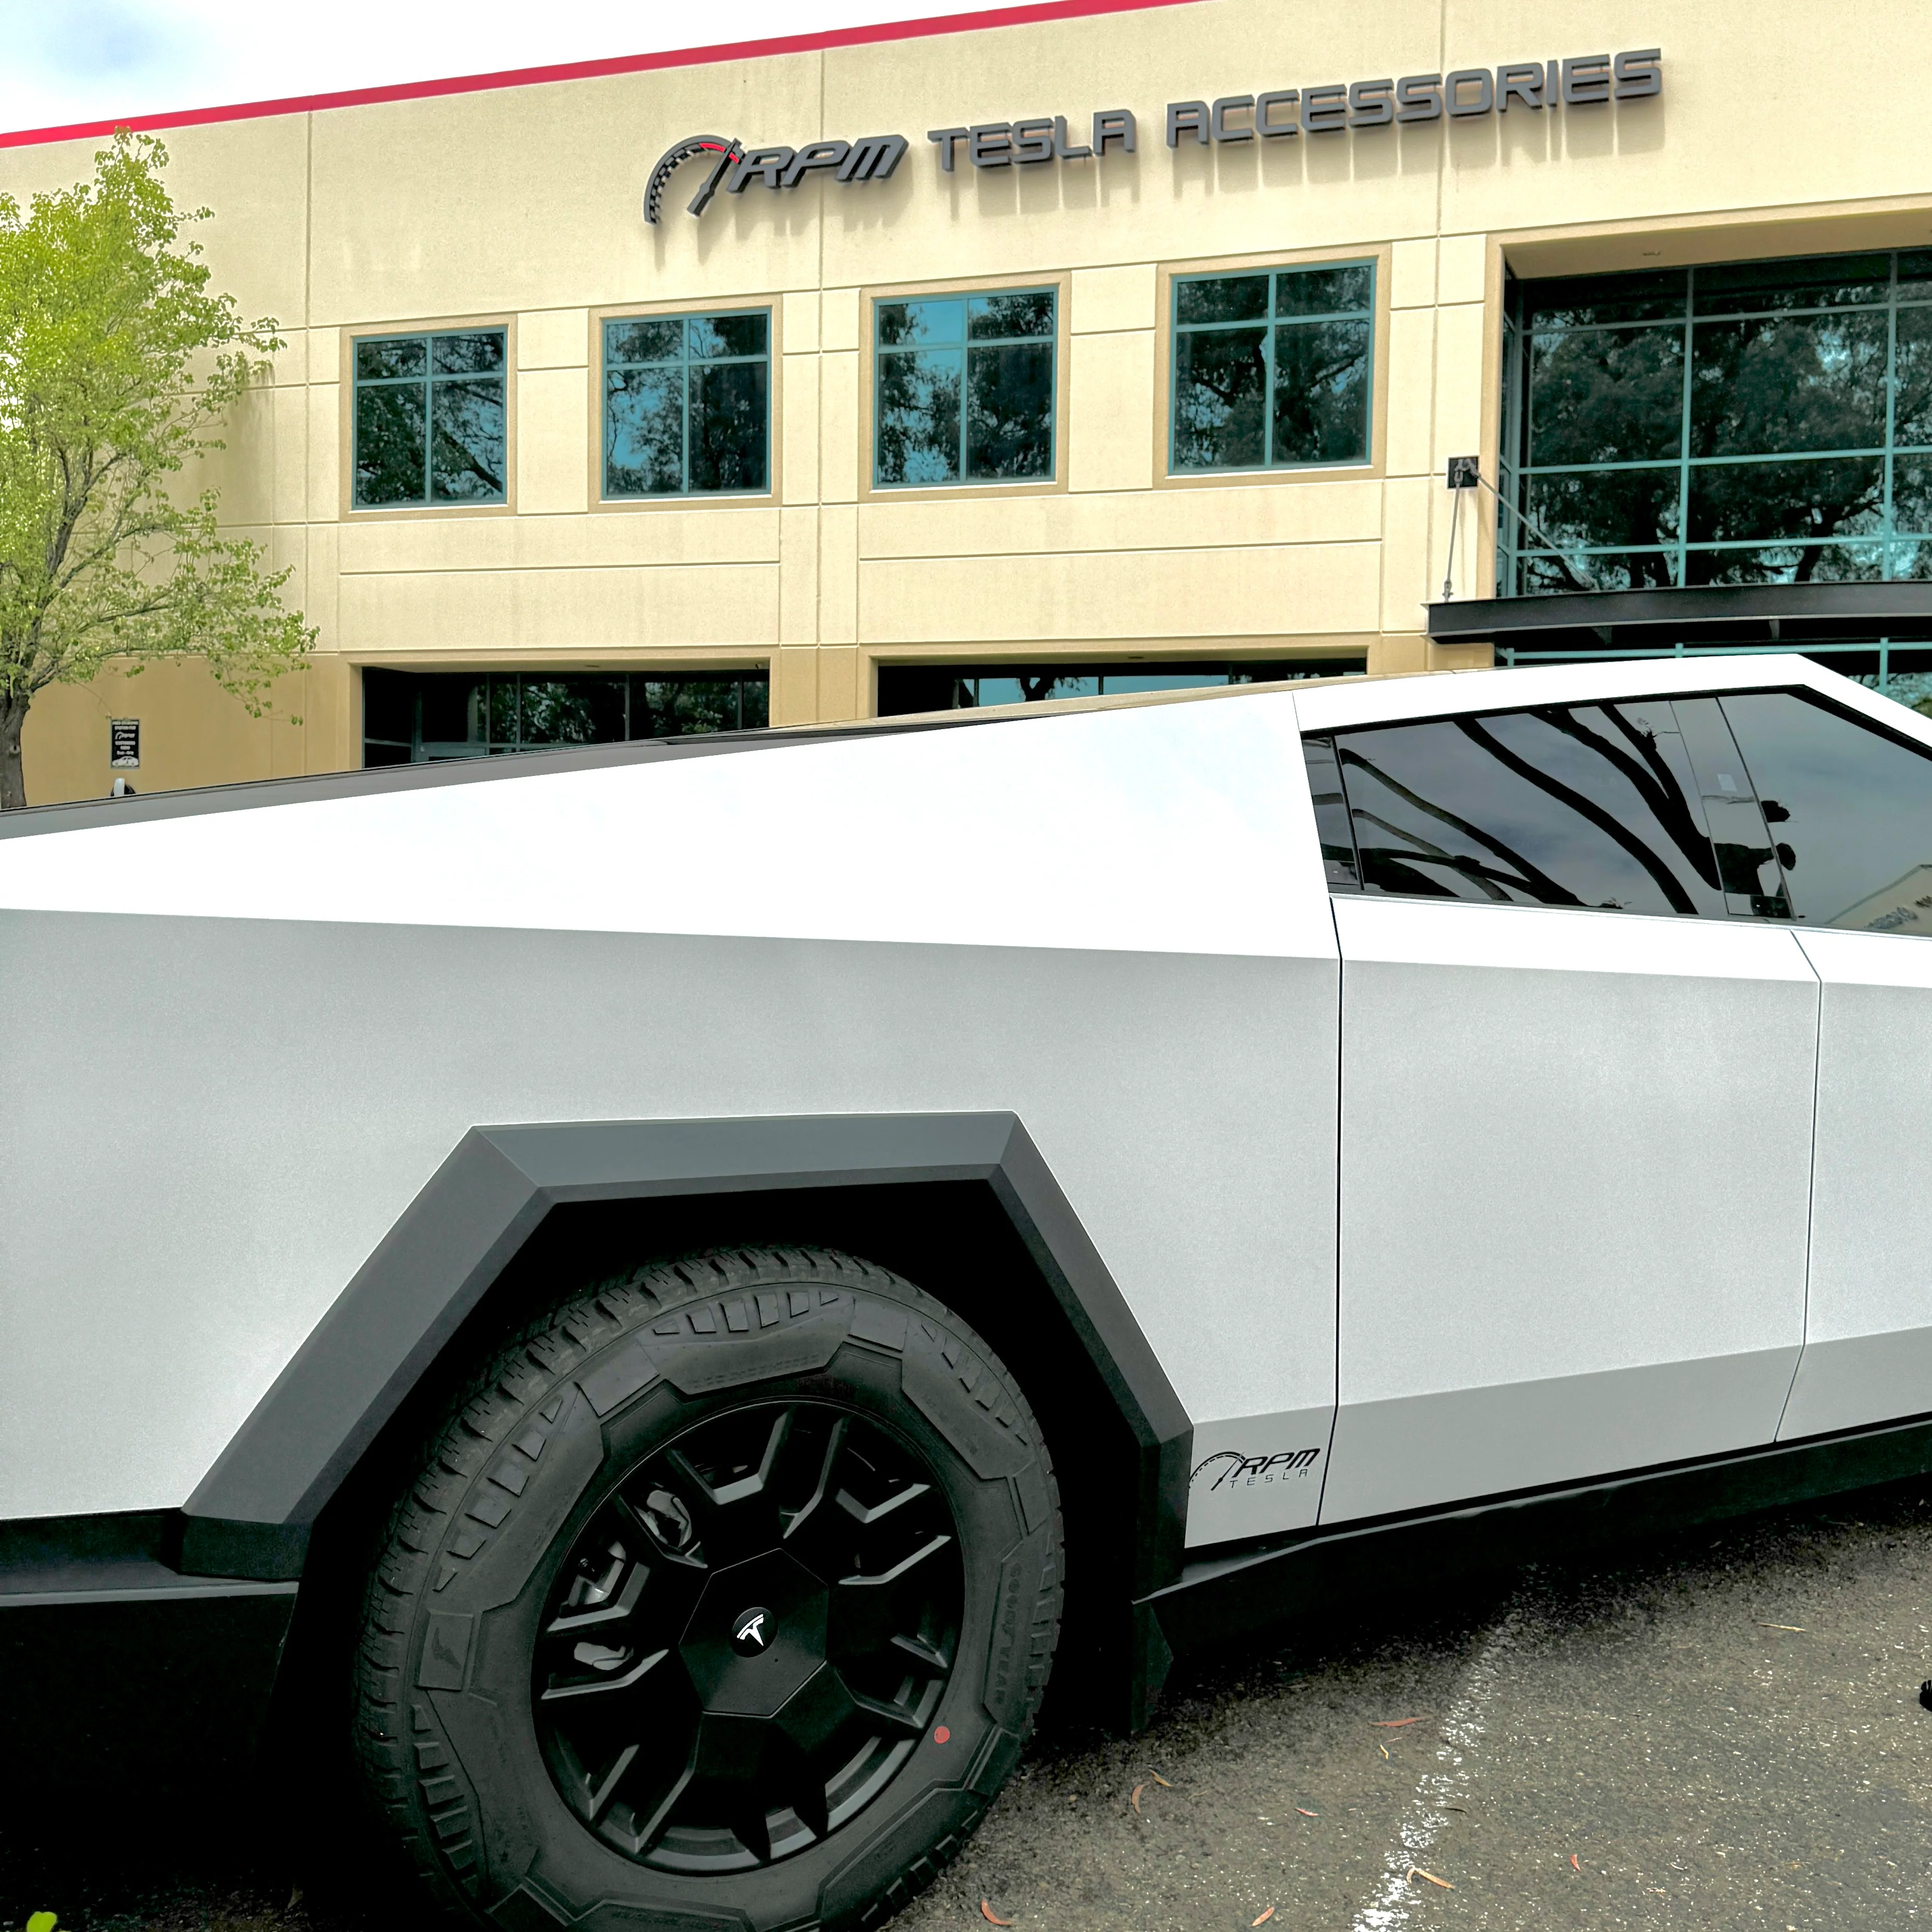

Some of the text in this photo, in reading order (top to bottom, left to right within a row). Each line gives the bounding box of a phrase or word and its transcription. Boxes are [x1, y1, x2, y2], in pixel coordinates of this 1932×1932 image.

[727, 48, 1662, 193] RPM TESLA ACCESSORIES
[1232, 1448, 1320, 1478] RPM
[1230, 1469, 1308, 1489] TESLA
